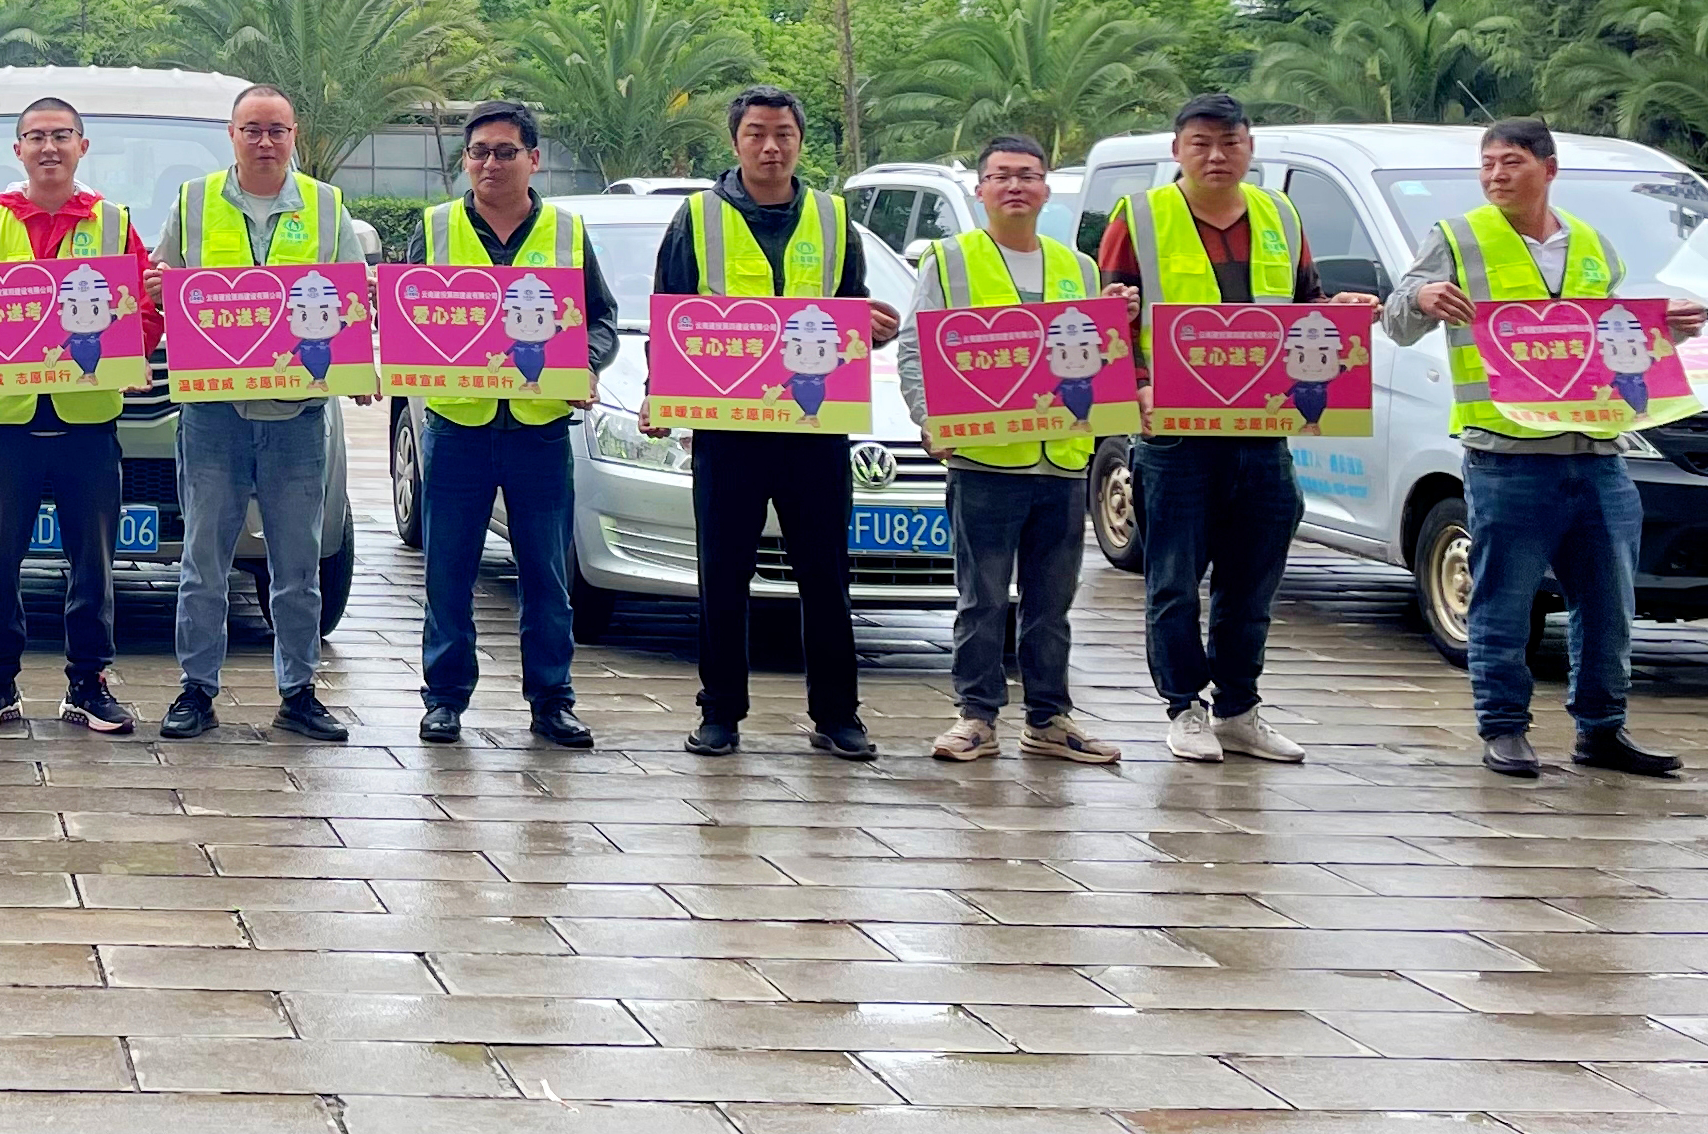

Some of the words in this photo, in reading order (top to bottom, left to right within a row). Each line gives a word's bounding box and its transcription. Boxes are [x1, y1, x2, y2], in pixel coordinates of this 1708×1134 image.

[198, 306, 272, 329] 爱心送考
[412, 305, 487, 327] 爱心送考
[685, 336, 765, 358] 爱心送考
[1188, 346, 1267, 367] 爱心送考
[1511, 338, 1586, 362] 爱心送考
[955, 346, 1031, 372] 爱心送考
[15, 369, 72, 385] 志愿同行
[178, 377, 235, 392] 温暖宣威
[245, 375, 302, 390] 志愿同行
[390, 373, 447, 387] 温暖宣威
[457, 374, 514, 389] 志愿同行
[659, 405, 719, 420] 温暖宣威
[730, 407, 791, 422] 志愿同行
[1163, 417, 1222, 430] 温暖宣威
[1234, 417, 1294, 431] 志愿同行
[1569, 408, 1625, 423] 志愿同行
[939, 421, 996, 438] 温暖宣威
[1006, 416, 1065, 433] 志愿同行
